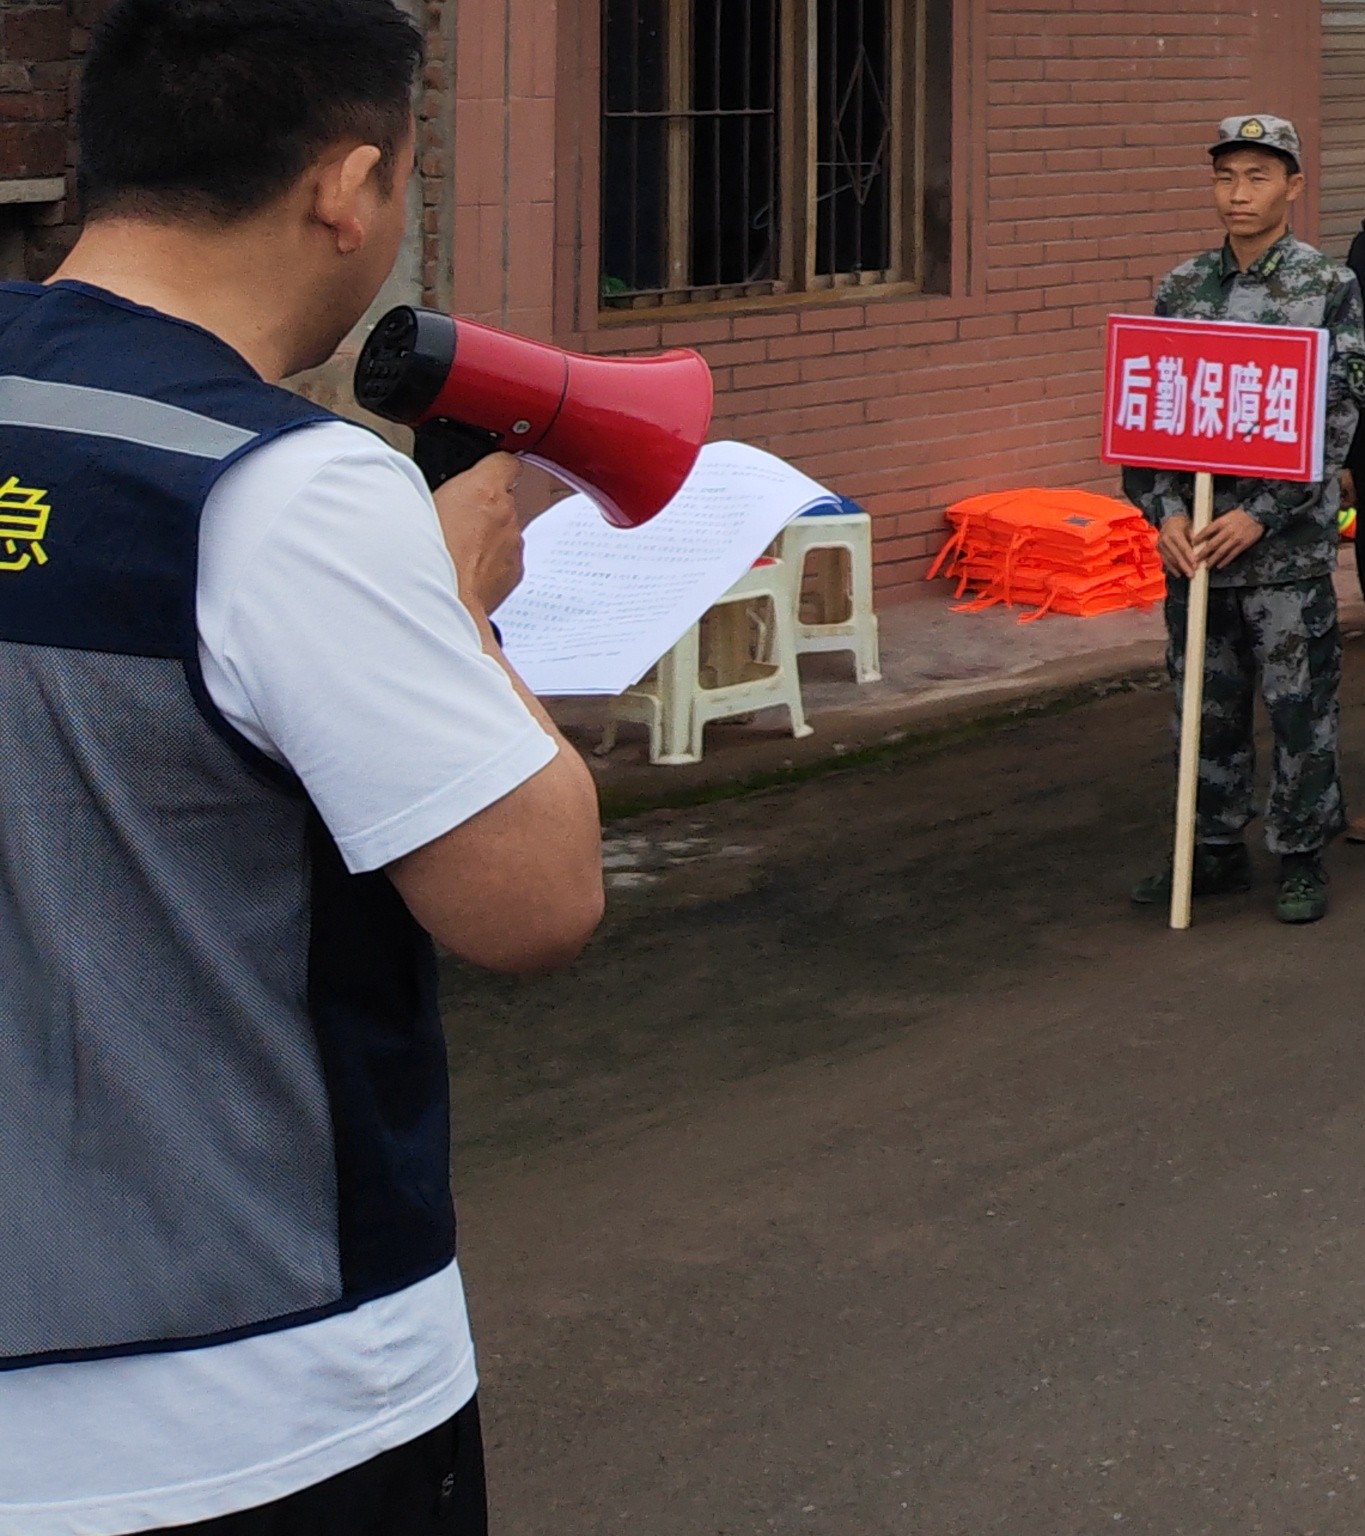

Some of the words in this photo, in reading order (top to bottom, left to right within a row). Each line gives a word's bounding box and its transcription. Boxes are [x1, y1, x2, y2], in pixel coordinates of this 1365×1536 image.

[1117, 355, 1299, 443] 后勤保障组
